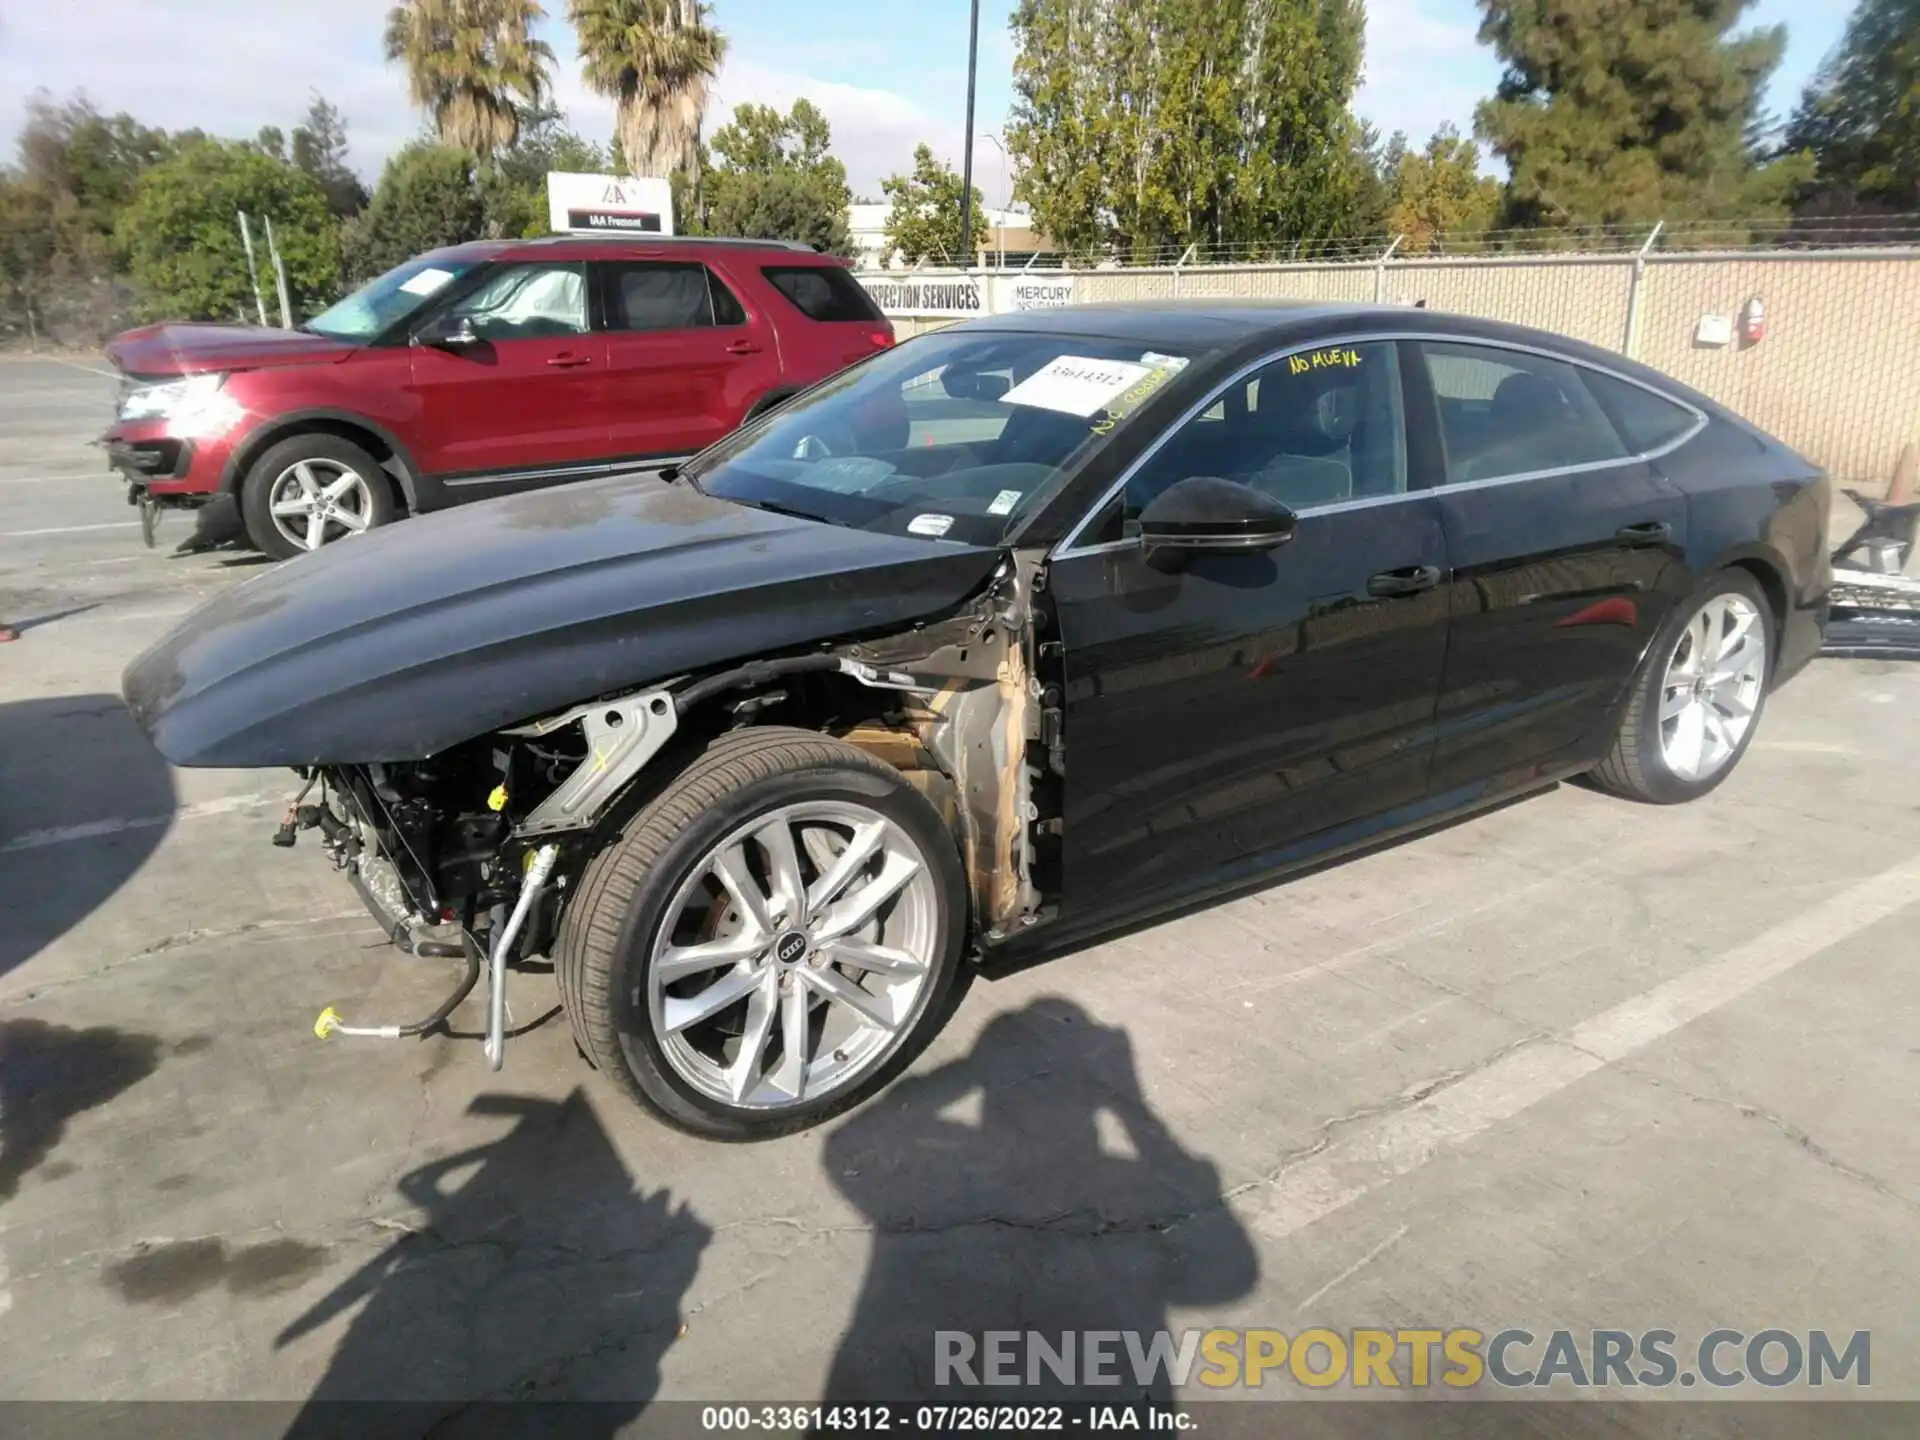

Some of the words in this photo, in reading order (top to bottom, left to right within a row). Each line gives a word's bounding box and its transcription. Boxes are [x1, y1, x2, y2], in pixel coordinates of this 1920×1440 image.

[863, 284, 921, 309] SPECTION
[922, 284, 980, 310] SERVICES
[1016, 286, 1072, 301] MERCURY
